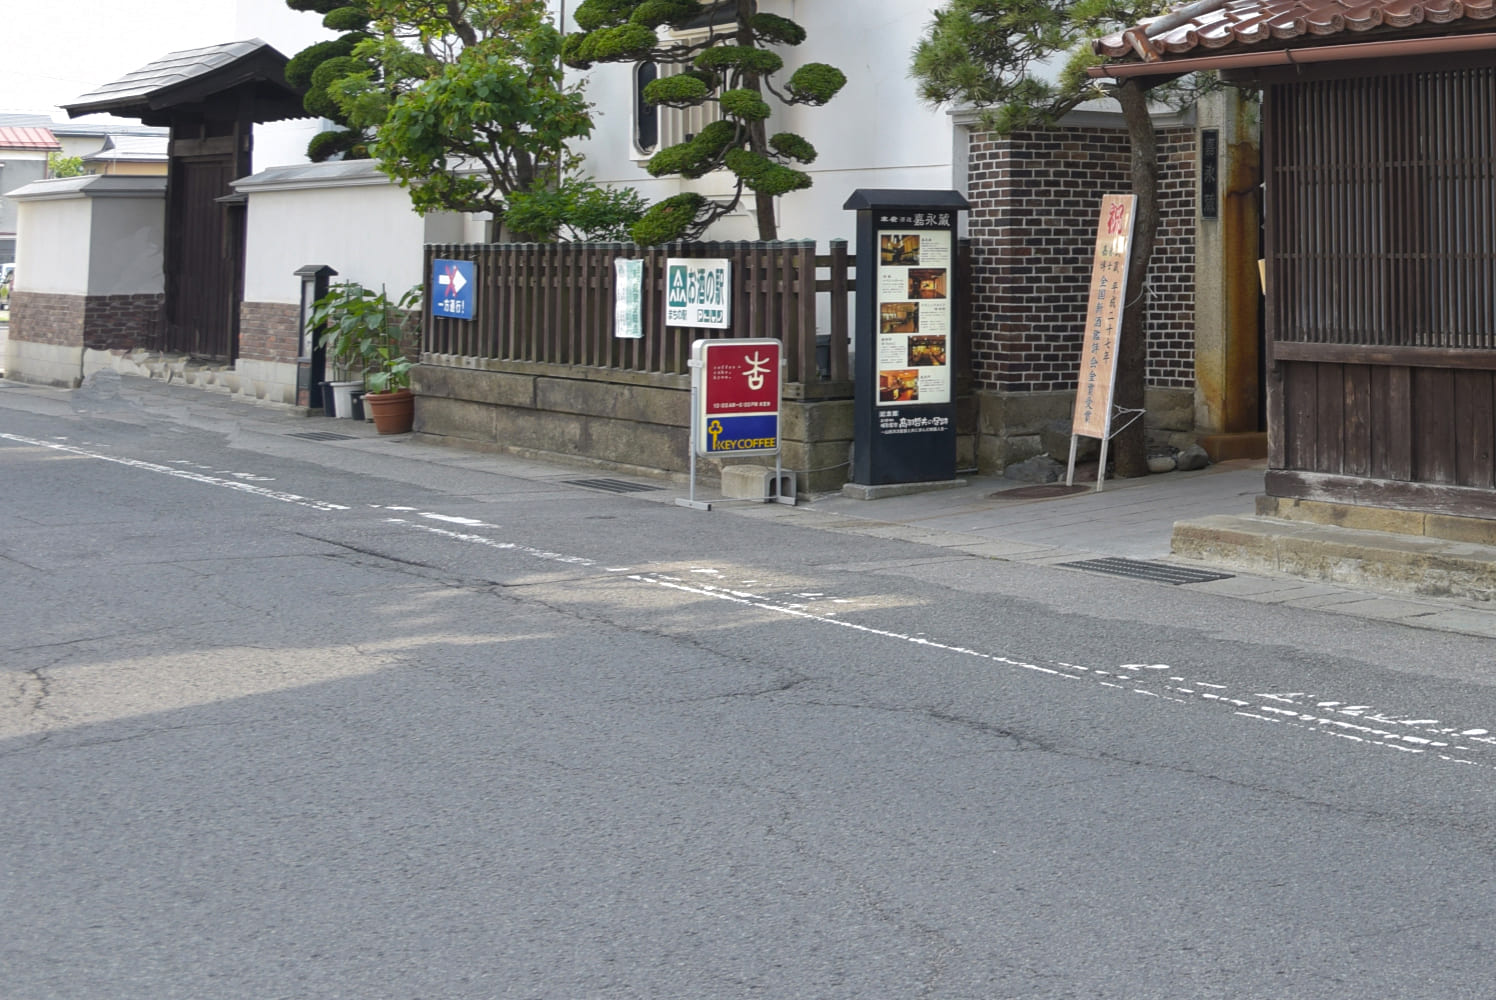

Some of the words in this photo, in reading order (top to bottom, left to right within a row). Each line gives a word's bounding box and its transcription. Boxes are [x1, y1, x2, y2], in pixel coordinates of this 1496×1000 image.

[687, 267, 724, 305] お酒の駅
[741, 350, 771, 390] 杏
[717, 439, 738, 450] KEY
[738, 437, 776, 449] COFFEE
